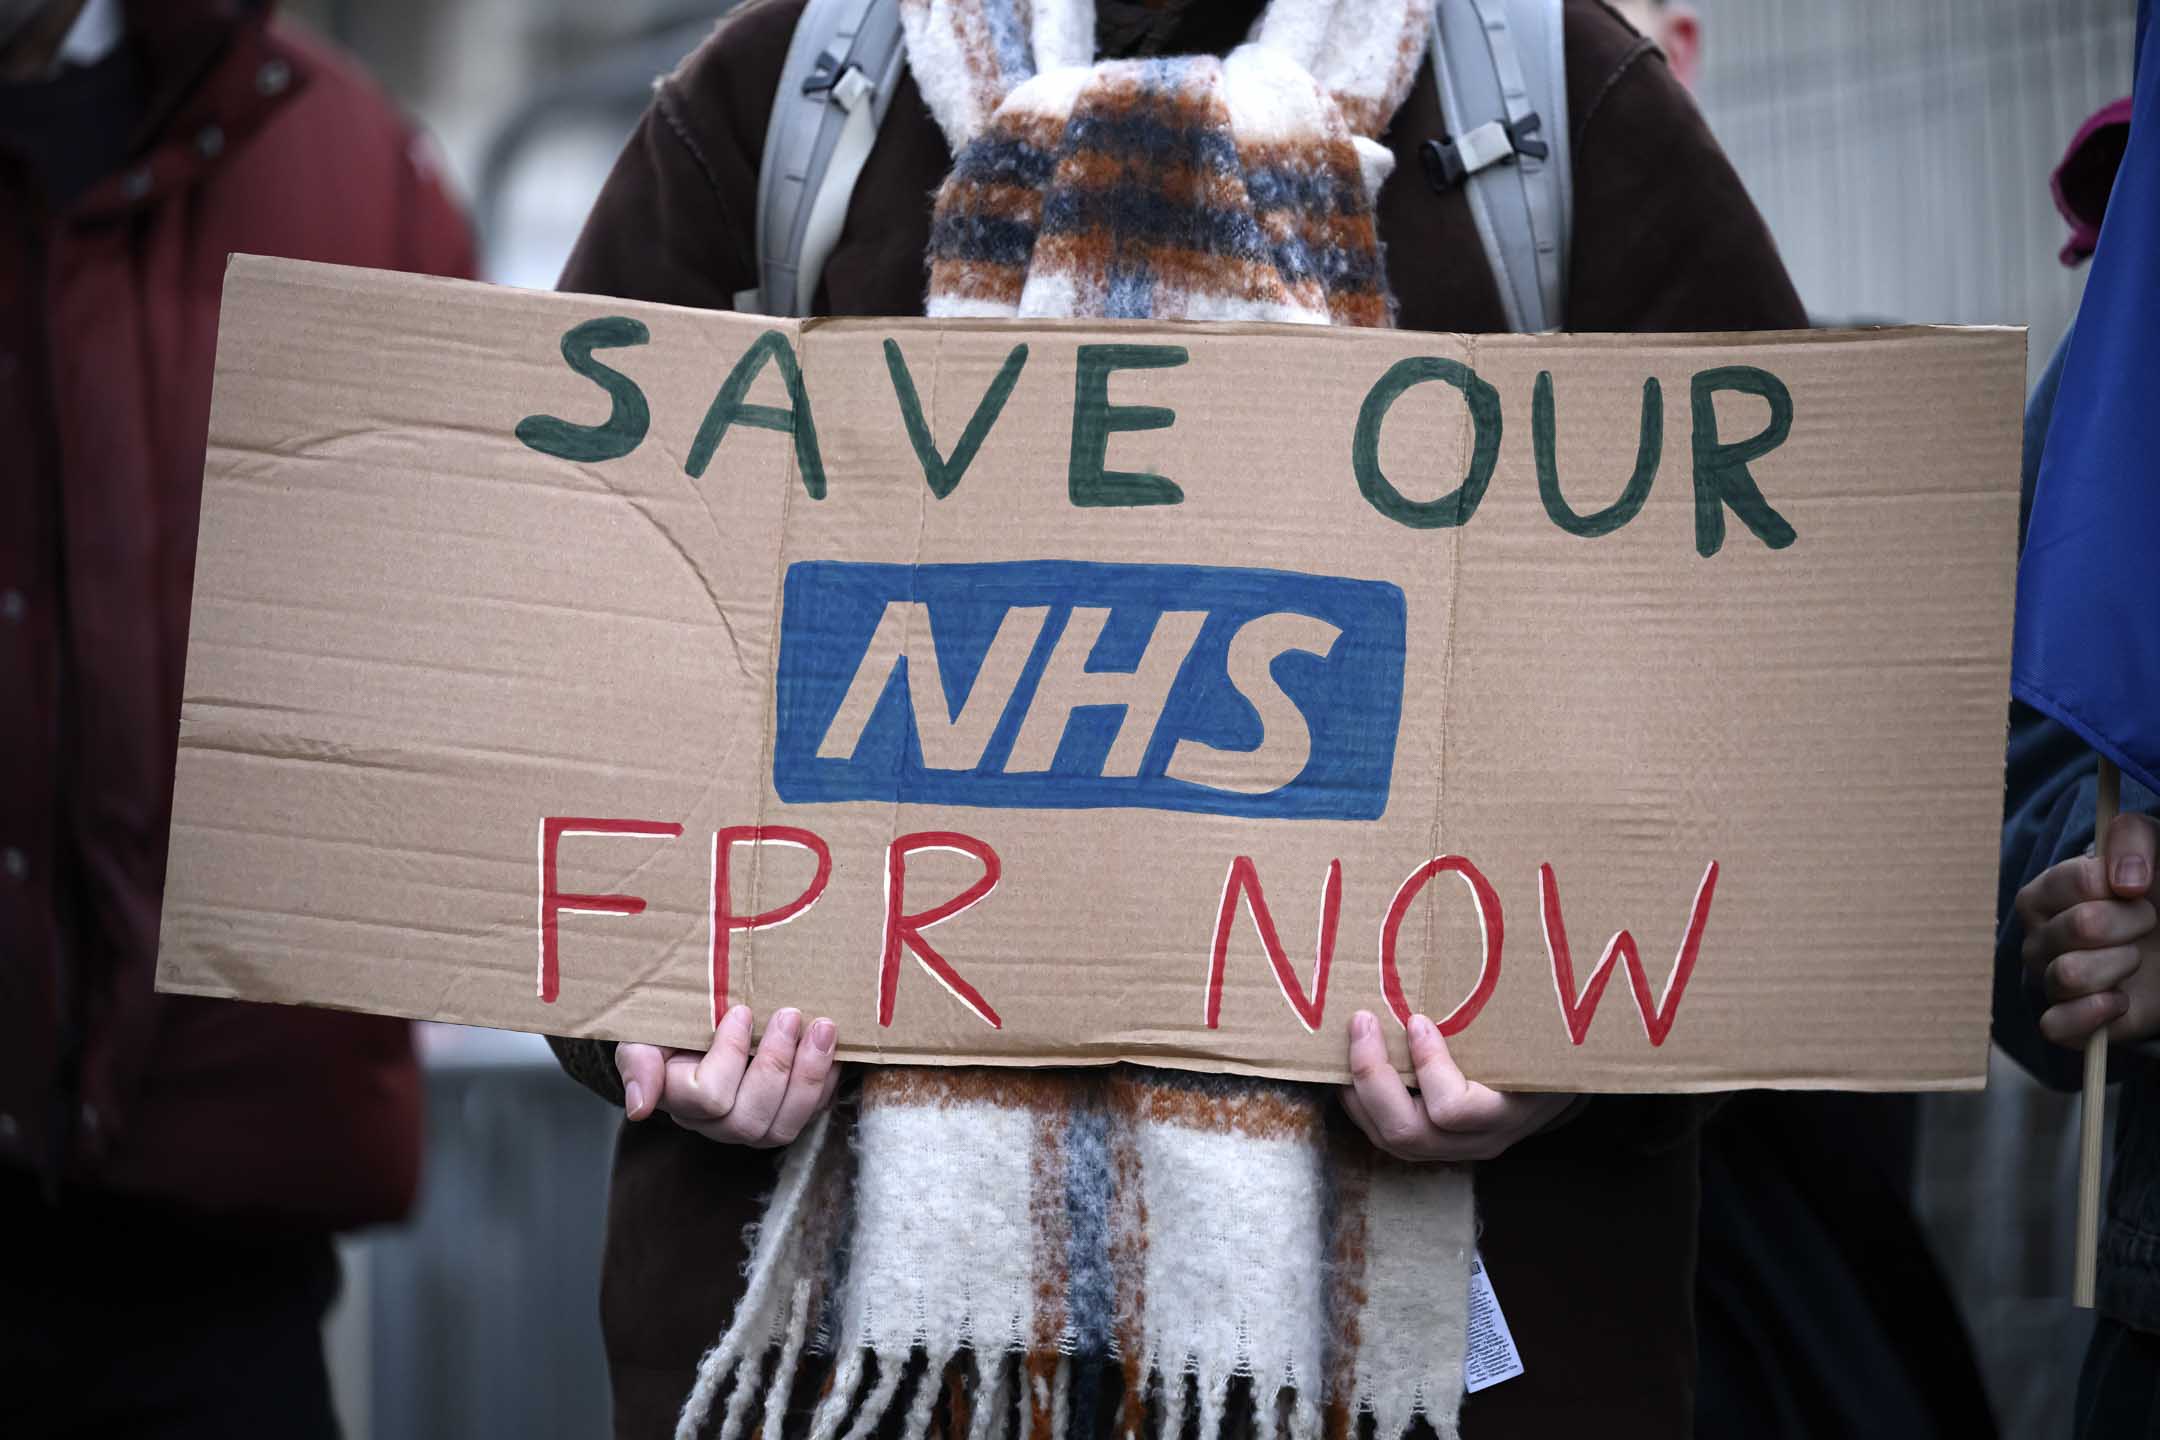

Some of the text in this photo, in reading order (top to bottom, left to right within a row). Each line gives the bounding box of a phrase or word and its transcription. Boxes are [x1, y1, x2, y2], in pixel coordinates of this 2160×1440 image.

[516, 317, 1797, 557] SAVE OUR
[815, 600, 1344, 796] NHS
[537, 816, 1719, 1047] FPR NOW
